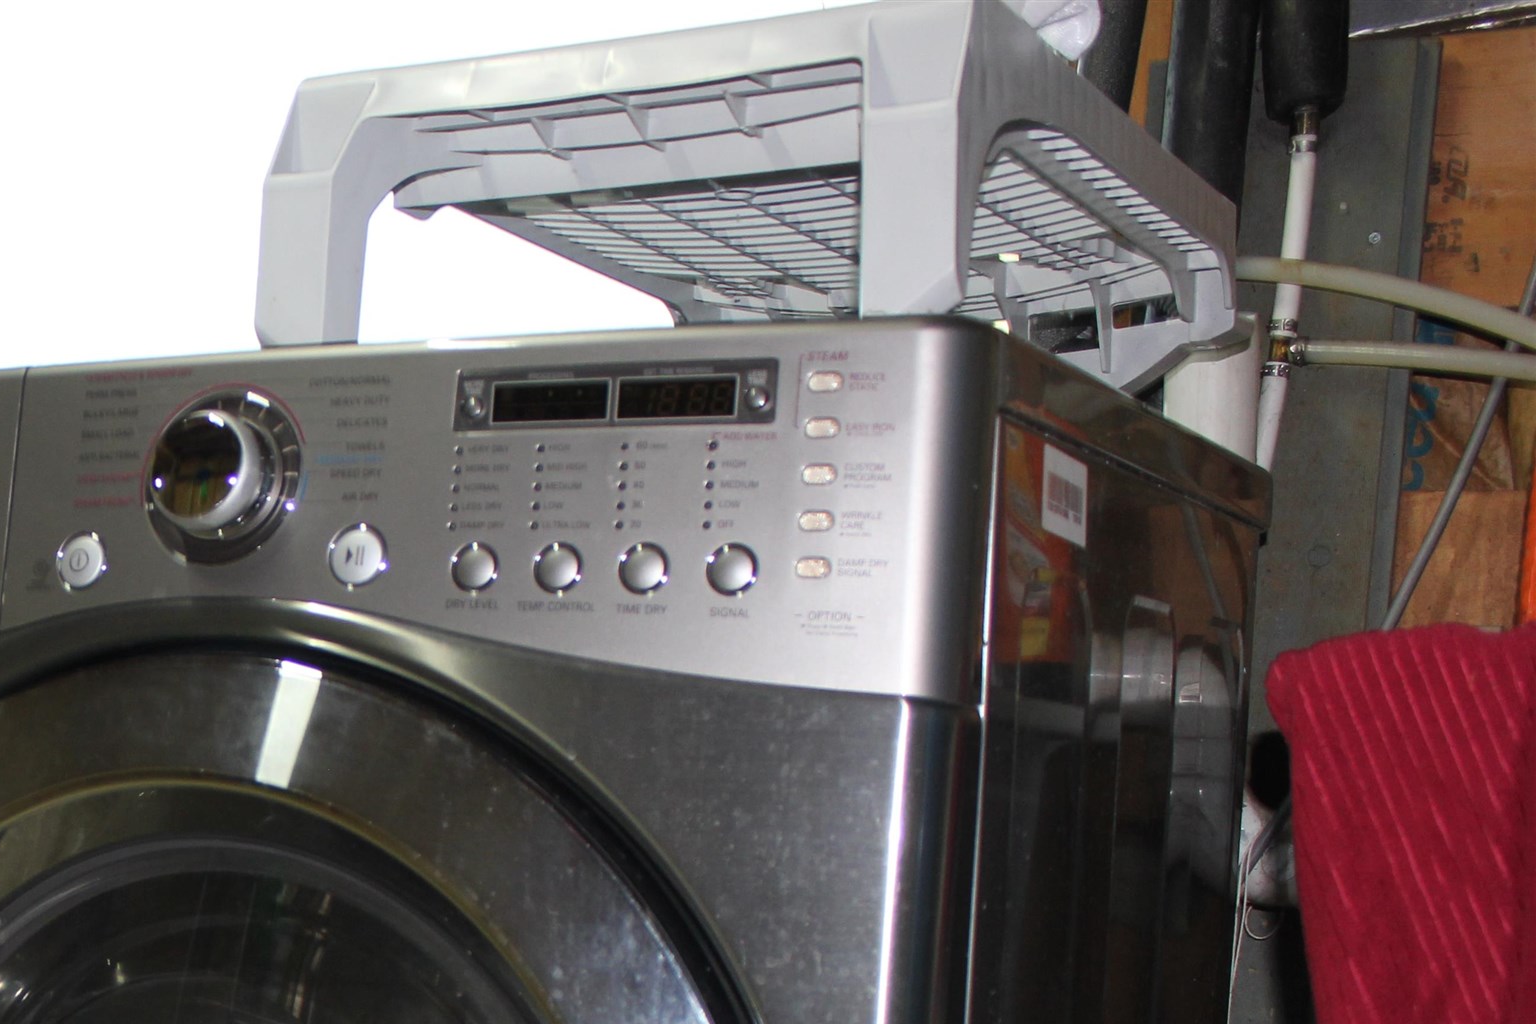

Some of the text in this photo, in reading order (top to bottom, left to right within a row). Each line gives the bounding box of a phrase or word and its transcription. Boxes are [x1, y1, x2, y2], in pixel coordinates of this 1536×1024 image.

[807, 350, 849, 361] STEAM
[469, 600, 499, 610] LEVEL
[547, 600, 595, 612] CONTROL
[616, 603, 668, 615] TIME DRY
[710, 606, 750, 618] SIGNAL
[807, 609, 853, 622] OPTION
